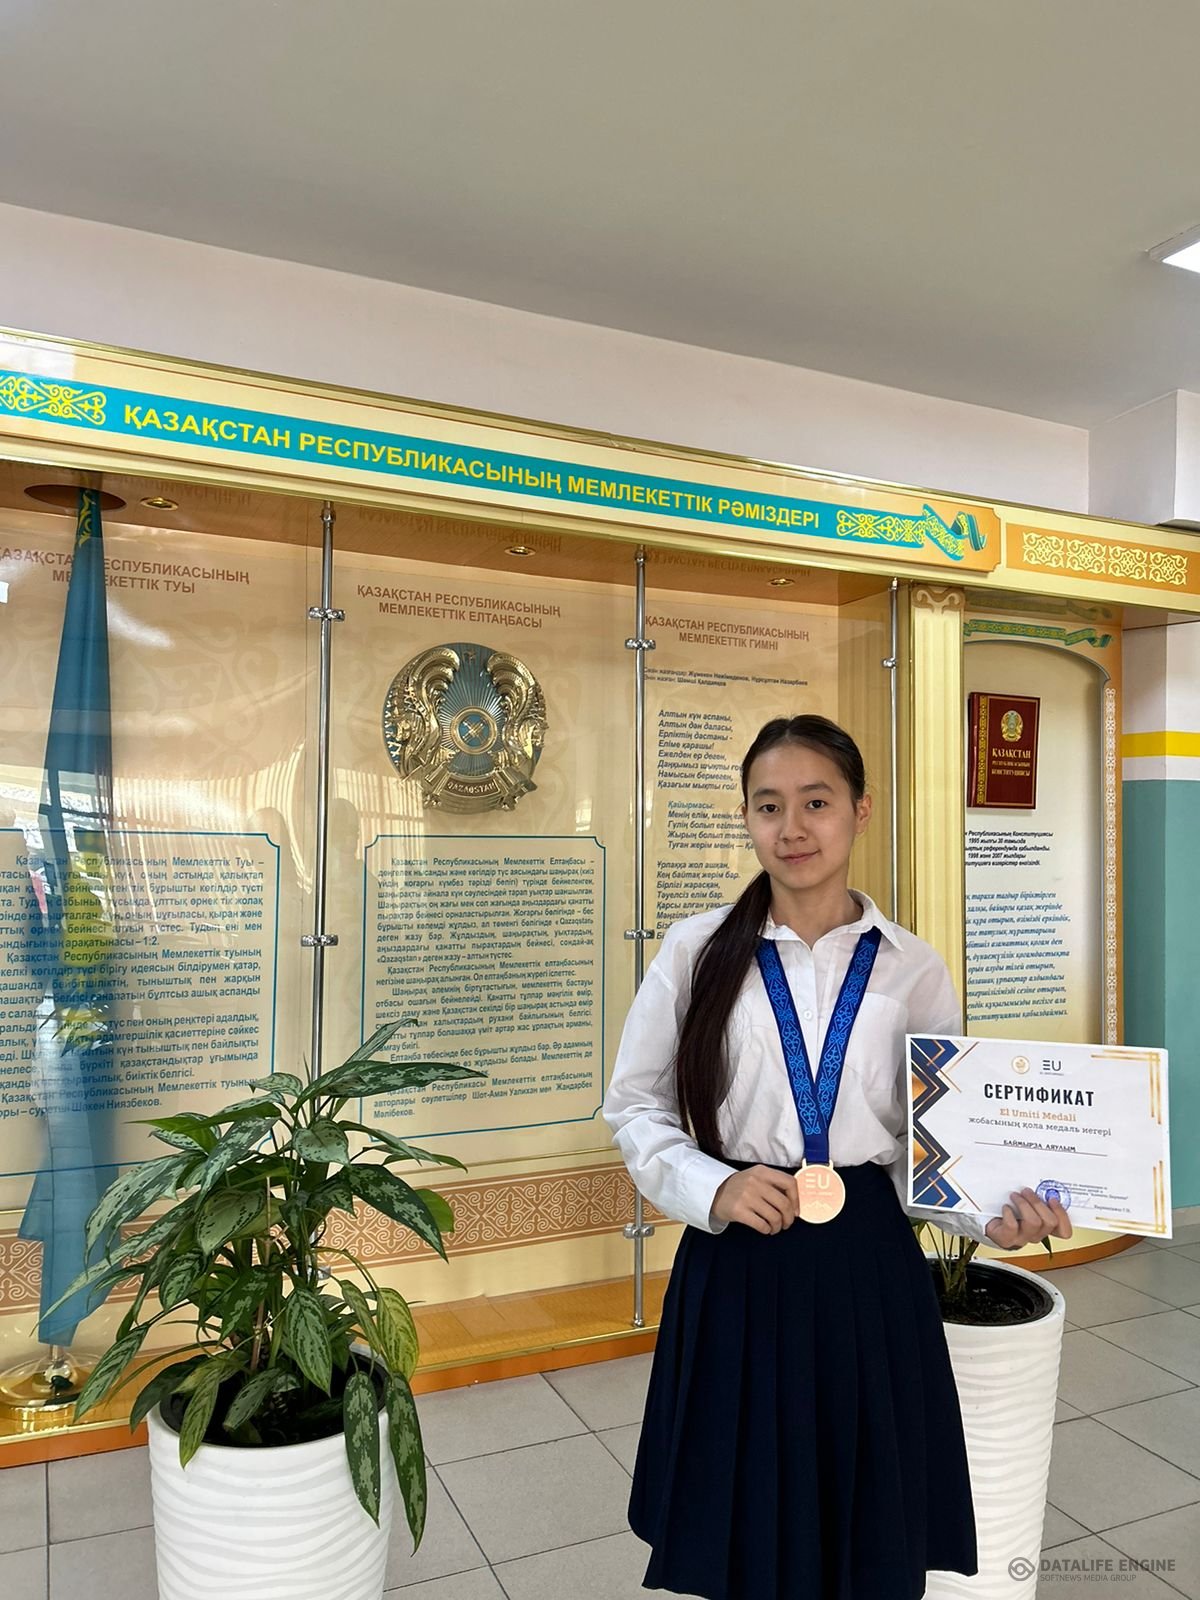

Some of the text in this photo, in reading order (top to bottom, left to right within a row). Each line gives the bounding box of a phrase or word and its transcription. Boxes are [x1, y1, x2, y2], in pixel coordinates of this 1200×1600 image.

[124, 404, 290, 448] ҚАЗАҚСТАН
[299, 432, 562, 494] РЕСПУБЛИКАСЫНЫҢ
[568, 476, 712, 513] МЕМЛЕКЕТТІК
[718, 499, 819, 528] РӘМІЗДЕРІ
[0, 547, 249, 584] АЗАҚСТА ЕСПУБЛИКАСЫНЫҢ
[164, 580, 195, 594] ТУЫ
[357, 585, 560, 617] ҚАЗАҚСТАН РЕСПУБЛИКАСЫНЫҢ
[379, 603, 542, 628] МЕМЛЕКЕТТІК ЕЛТАҢБАСЫ
[645, 615, 809, 641] ҚАЗАҚСТАН РЕСПУБЛИКАСЫНЫҢ
[679, 632, 778, 650] МЕМЛЕКЕТТІК ГИМНІ
[659, 710, 686, 718] Алтын
[703, 714, 732, 722] аспаны,
[659, 720, 687, 728] Алтын
[704, 722, 733, 732] даласы,
[659, 730, 728, 740] Ерліктің дастаны
[659, 740, 680, 748] Еліме
[658, 750, 691, 758] Ежелден
[992, 748, 1030, 758] ҚАЗАҚСТАН
[658, 760, 698, 769] Даңқымыз
[658, 770, 695, 779] Намысын
[658, 780, 690, 789] Қазағым
[668, 801, 714, 810] Қайырмасы:
[173, 857, 254, 868] Мемлекеттік Туы
[433, 858, 499, 867] Республикасының
[550, 858, 586, 866] Елтаңбасы
[149, 883, 263, 895] бұрышты көгілдір түсті
[657, 881, 682, 889] Бірлігі
[657, 891, 688, 900] Тәуелсіз
[64, 937, 159, 949] арақатынасы 1:2.
[7, 949, 262, 964] Қазақстан Республикасының Мемлекеттік туының
[100, 962, 261, 976] бірігу идеясын білдірумен қатар,
[137, 978, 192, 987] тыныштық
[224, 976, 260, 986] жарқын
[148, 989, 260, 1001] бұлтсыз ашық аспанды
[376, 1010, 400, 1018] шексіз
[442, 1006, 478, 1016] Қазақстан
[479, 1004, 504, 1013] секілді
[505, 1004, 516, 1012] бір
[517, 1004, 548, 1012] шаңырақ
[108, 1021, 125, 1030] түс
[146, 1019, 172, 1028] оның
[173, 1015, 214, 1028] реңктері
[216, 1016, 259, 1025] адалдық,
[164, 1025, 259, 1041] қасиеттеріне сәйкес
[117, 1047, 134, 1057] күн
[135, 1045, 190, 1055] тыныштық
[211, 1040, 258, 1051] байлықты
[390, 1054, 421, 1063] Елтаңба
[474, 1048, 508, 1058] бұрышты
[120, 1055, 258, 1070] қазақстандықтар ұғымында
[126, 1070, 194, 1080] биіктік белгісі.
[158, 1081, 217, 1092] Мемлекеттік
[432, 1072, 593, 1093] Республикасы Мемлекеттік елтаңбасының
[984, 1083, 1094, 1106] СЕРТИФИКАТ
[107, 1099, 162, 1109] Ниязбеков.
[1000, 1108, 1076, 1122] El Umiti Medali
[968, 1117, 1020, 1128] жобасының
[1046, 1124, 1080, 1132] медаль
[1082, 1128, 1112, 1136] иегері
